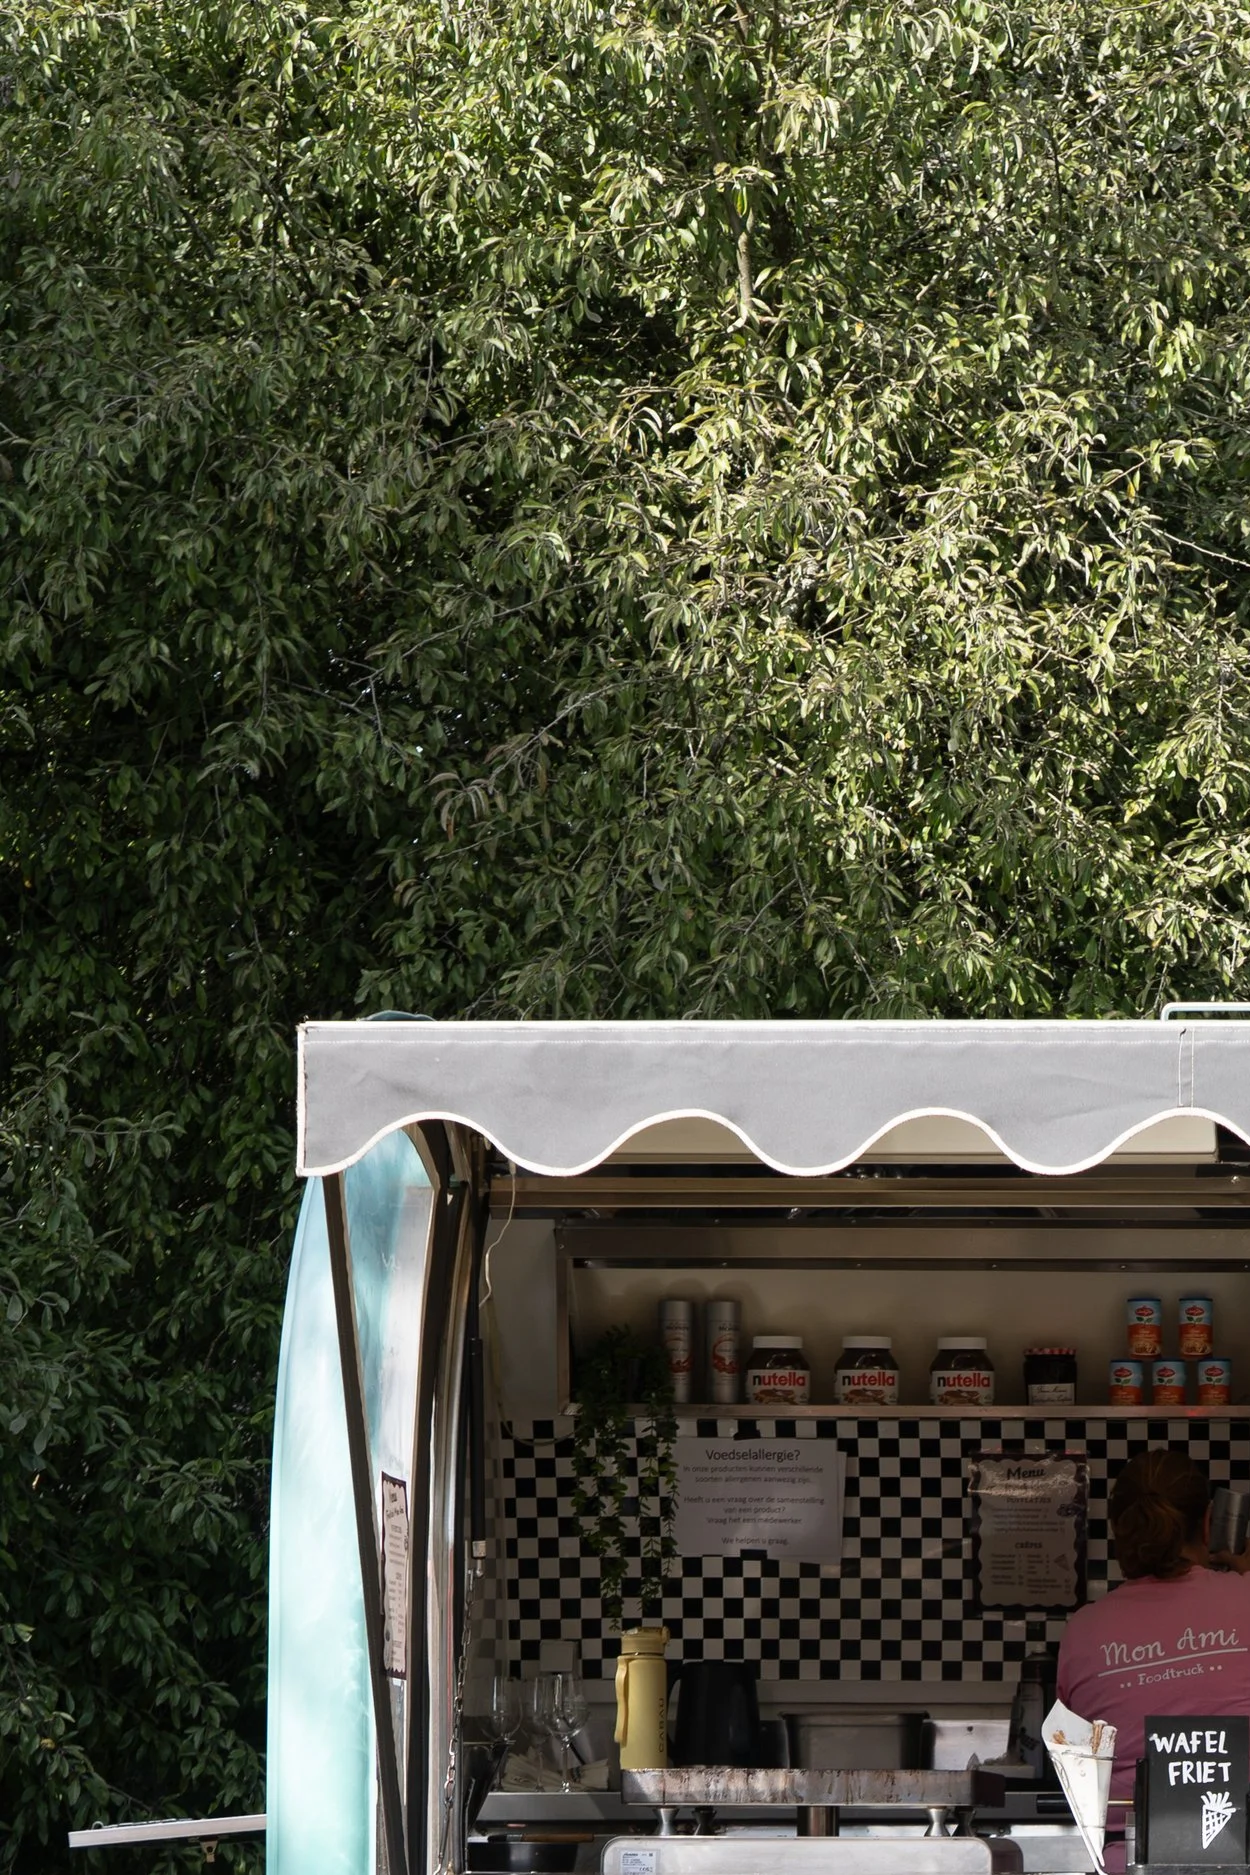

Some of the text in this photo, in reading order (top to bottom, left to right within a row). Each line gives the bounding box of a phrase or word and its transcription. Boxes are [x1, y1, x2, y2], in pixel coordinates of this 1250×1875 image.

[753, 1372, 805, 1387] nutella
[842, 1372, 895, 1387] nutella
[937, 1373, 990, 1388] nutella
[705, 1448, 801, 1463] Voedselallergie?
[1006, 1467, 1046, 1479] Menu
[727, 1497, 747, 1505] vraag
[1100, 1627, 1239, 1666] Mon Ami
[1138, 1663, 1205, 1686] Foodtruck
[1149, 1731, 1228, 1754] WAFEL
[1168, 1760, 1232, 1786] FRIET
